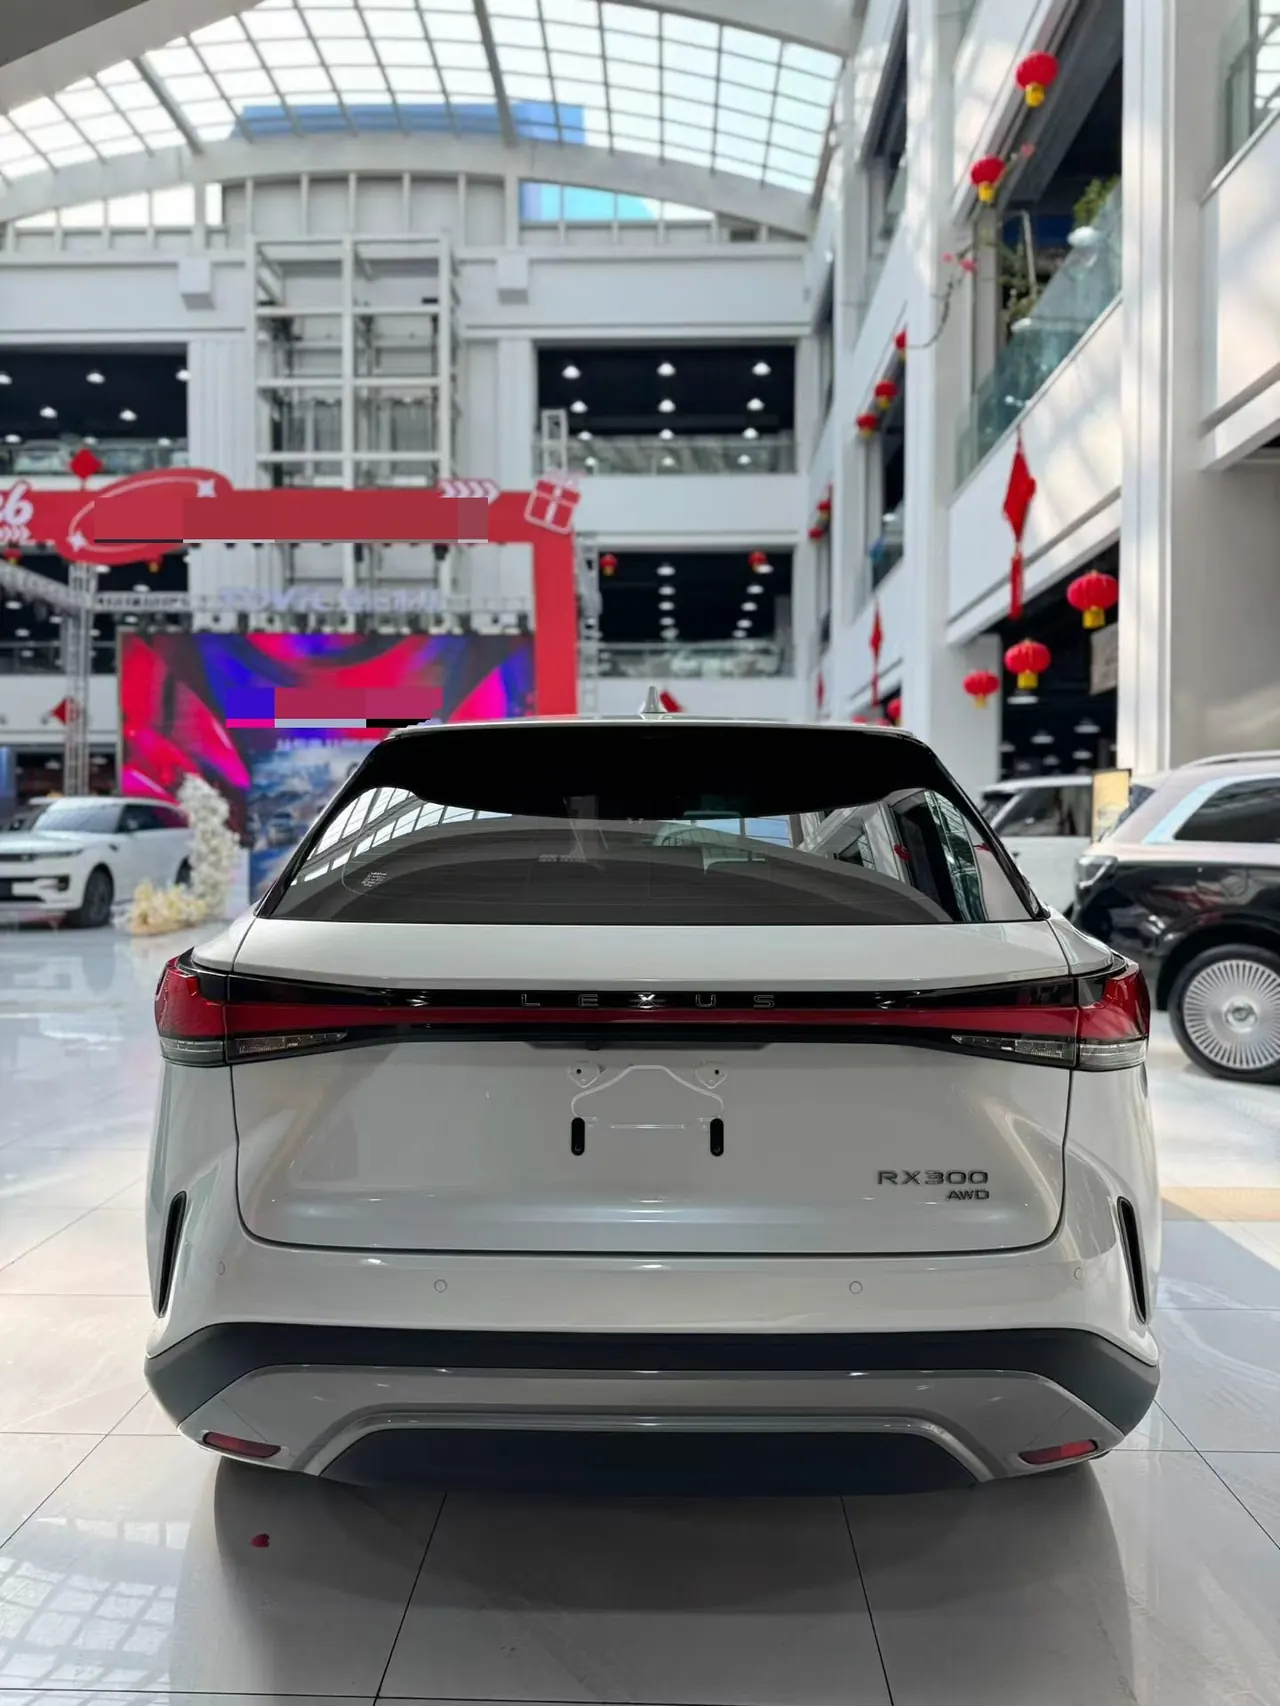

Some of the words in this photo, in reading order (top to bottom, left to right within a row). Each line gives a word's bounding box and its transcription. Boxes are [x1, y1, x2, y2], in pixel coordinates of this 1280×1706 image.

[521, 993, 776, 1009] LEXUS
[877, 1170, 989, 1186] RX300
[947, 1189, 990, 1201] AWD
